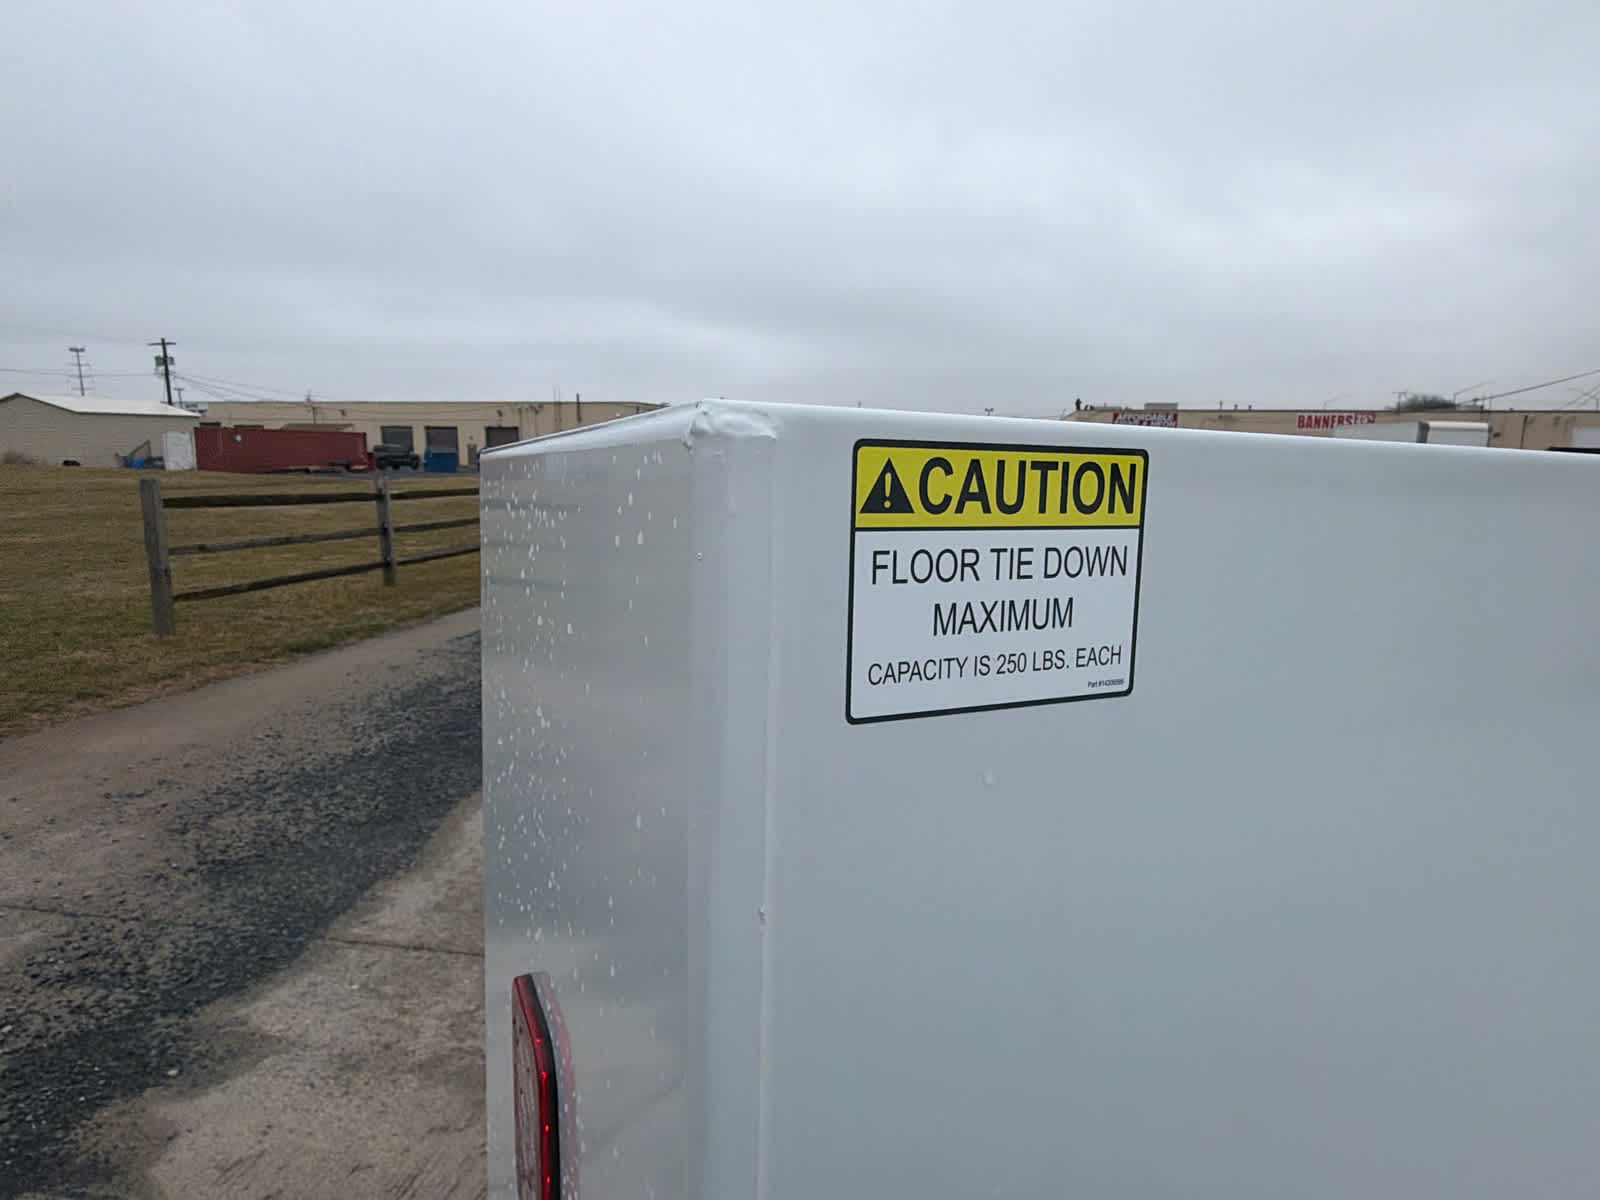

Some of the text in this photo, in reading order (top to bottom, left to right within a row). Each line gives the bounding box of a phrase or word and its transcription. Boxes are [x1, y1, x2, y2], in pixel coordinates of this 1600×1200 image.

[918, 456, 1137, 515] CAUTION
[872, 545, 1128, 585] FLOOR TIE DOWN
[932, 597, 1074, 636] MAXIMUM
[867, 645, 1122, 686] CAPACITY IS 250 LBS. EACH
